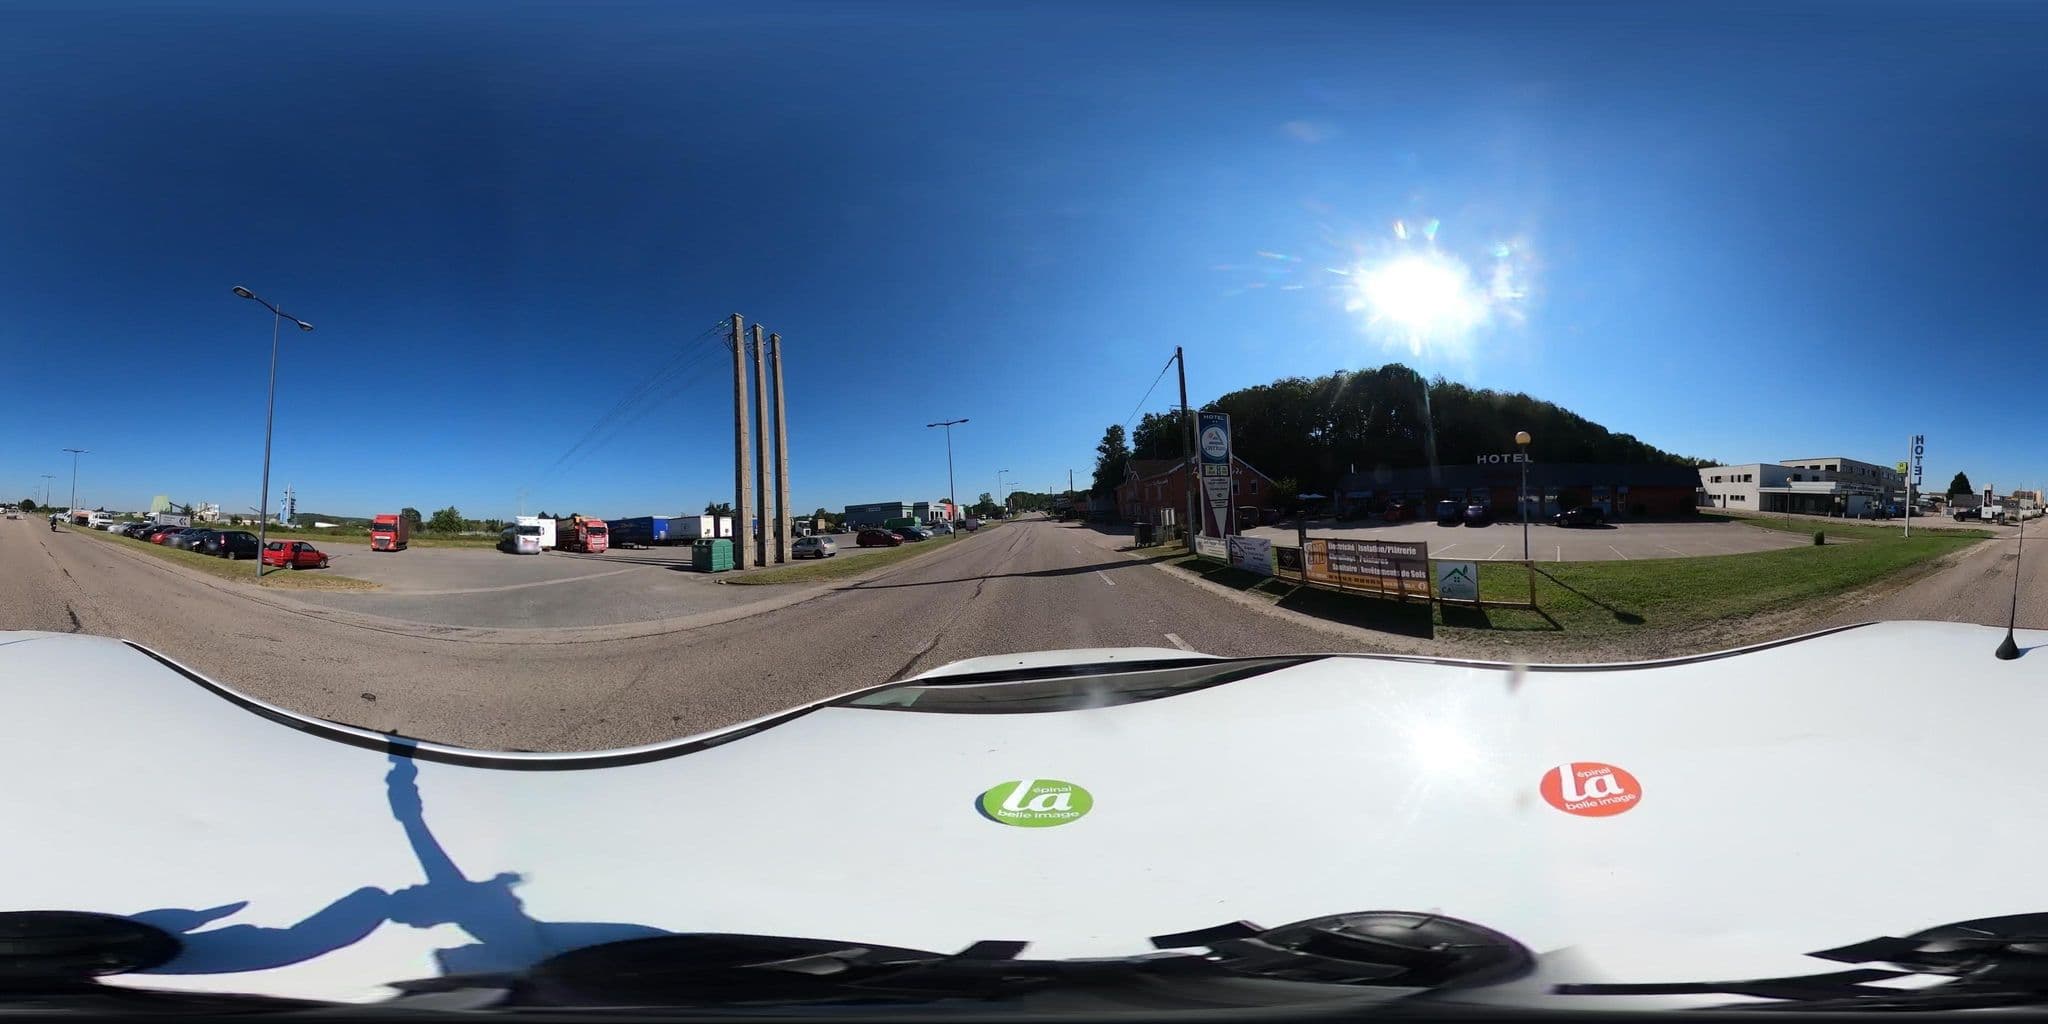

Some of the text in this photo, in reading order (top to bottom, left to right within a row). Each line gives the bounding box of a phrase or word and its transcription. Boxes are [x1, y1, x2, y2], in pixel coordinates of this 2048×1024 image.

[1476, 453, 1534, 464] HOTEL
[1411, 569, 1427, 578] Sols
[1558, 763, 1625, 802] la
[1002, 778, 1072, 812] la
[1566, 793, 1636, 810] belle image
[997, 809, 1080, 819] belle image
